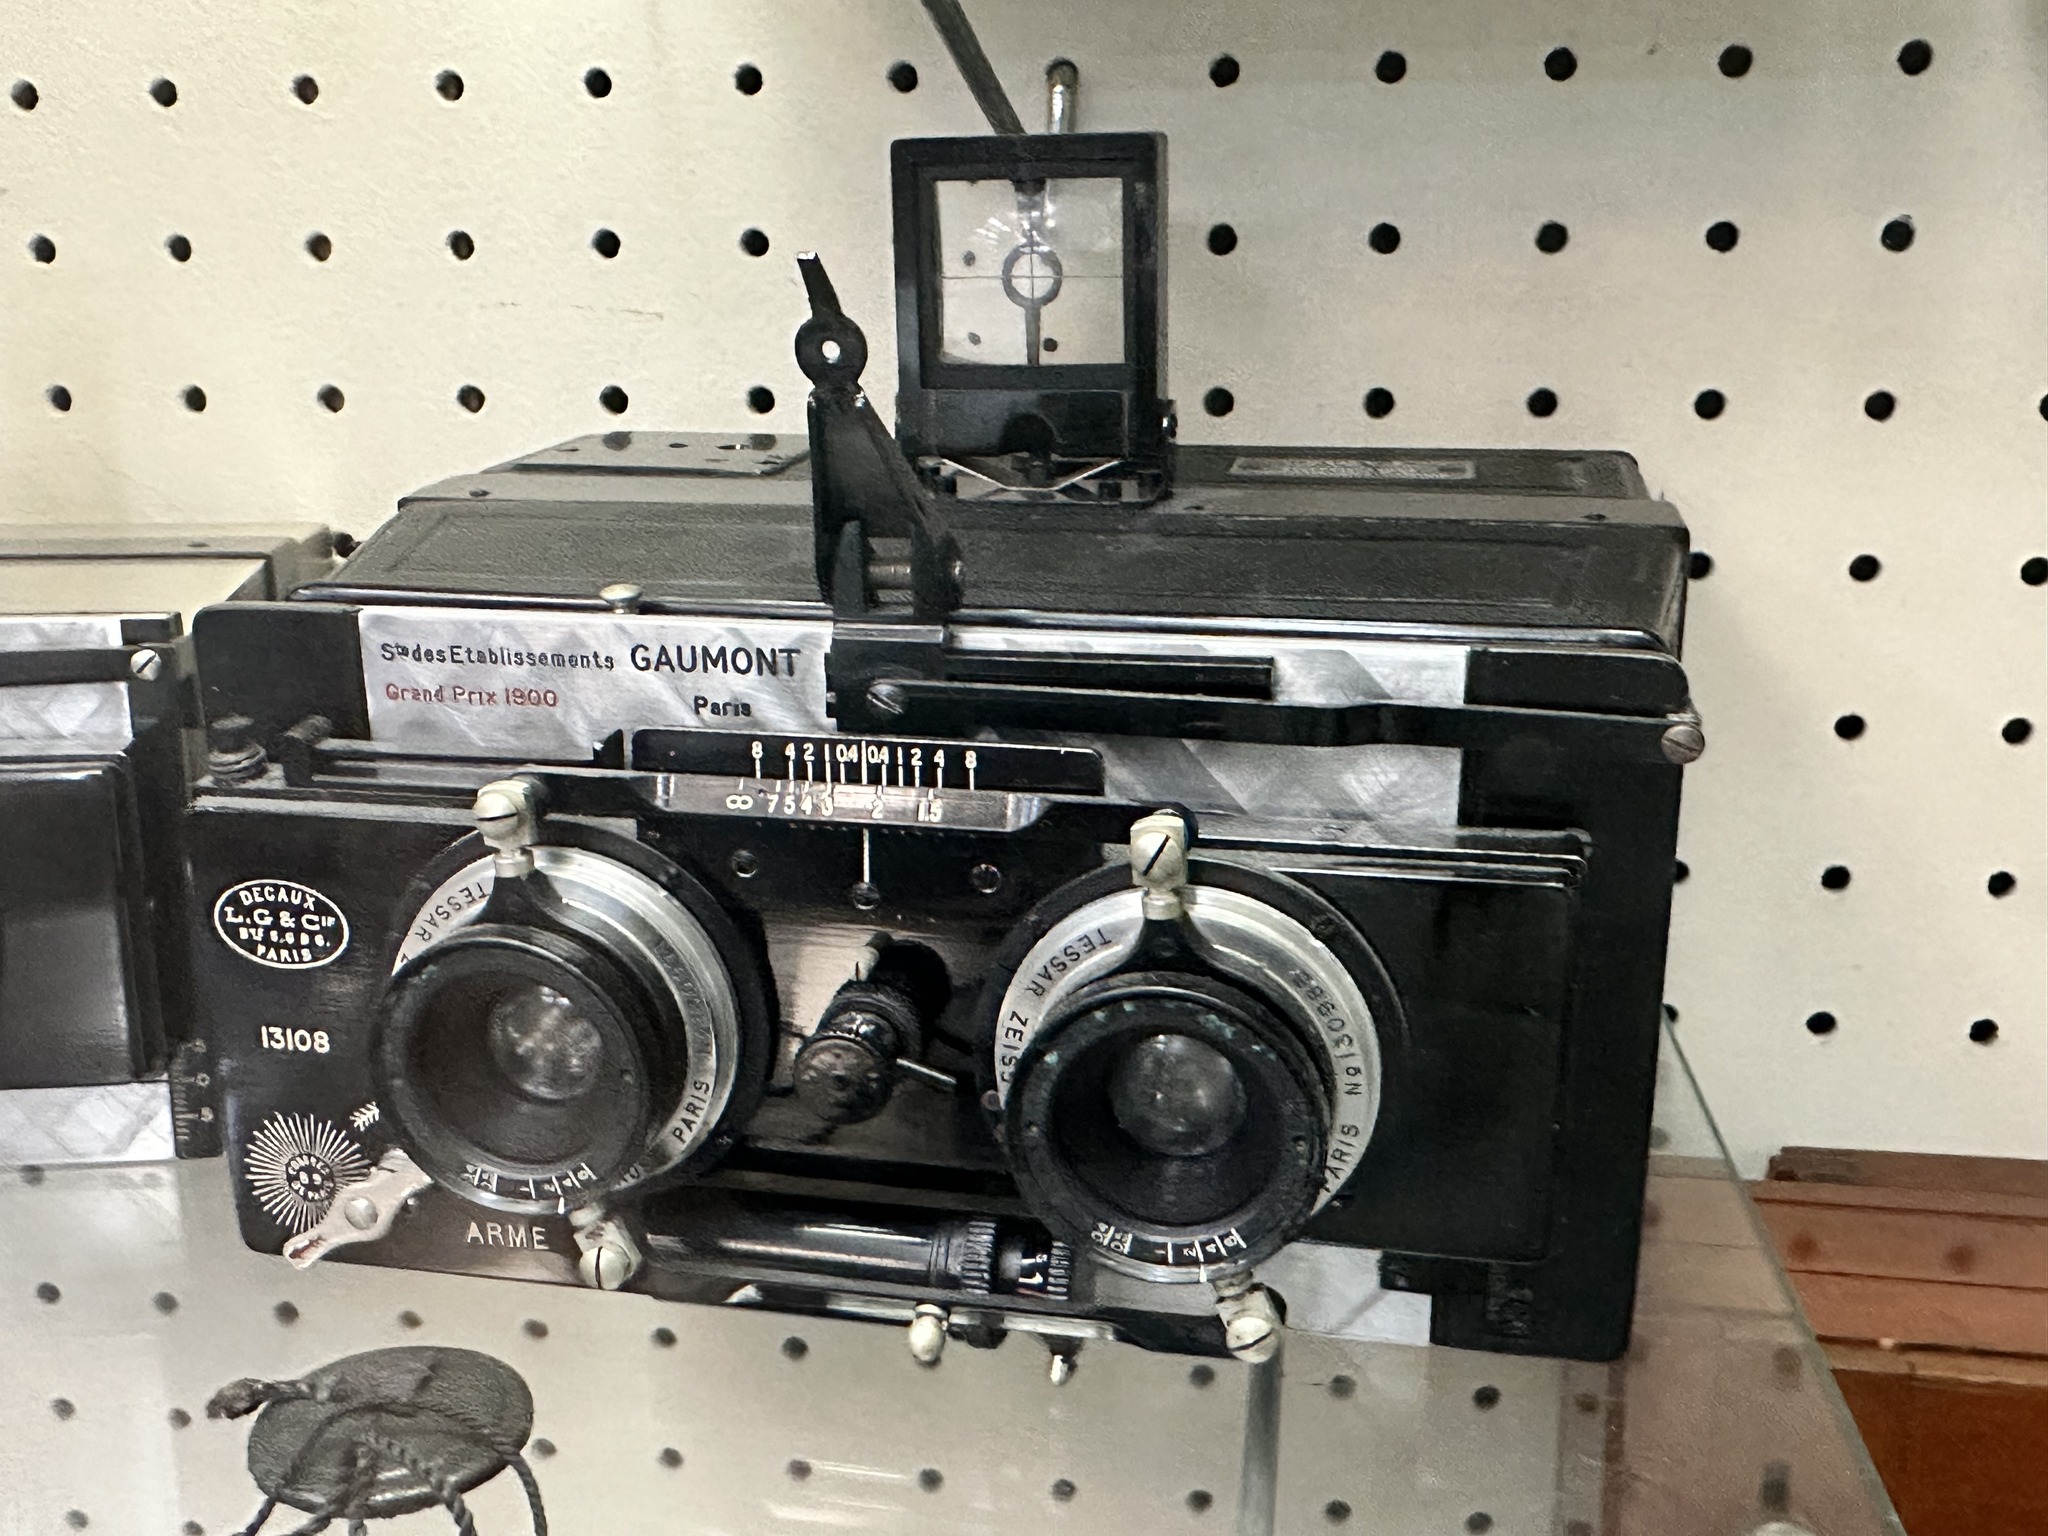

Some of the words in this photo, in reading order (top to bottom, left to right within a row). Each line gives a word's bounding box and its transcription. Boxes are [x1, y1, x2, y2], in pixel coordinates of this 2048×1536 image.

[630, 644, 801, 677] GAUMONT
[385, 683, 444, 704] Grand
[452, 685, 497, 706] Prix
[505, 686, 559, 708] 1900
[694, 695, 752, 717] Paris
[751, 741, 764, 759] 8
[785, 743, 796, 760] 4
[803, 743, 815, 762] 2
[911, 748, 923, 767] 2
[934, 749, 946, 768] 4
[965, 750, 977, 769] 8
[871, 800, 884, 820] 2
[239, 885, 316, 912] DECAUX
[414, 882, 491, 942] TESSAR
[256, 943, 313, 963] PARIS
[1023, 928, 1113, 998] TESSAR
[260, 1025, 331, 1054] 13108
[671, 1080, 711, 1145] PARIS
[466, 1220, 550, 1251] ARME
